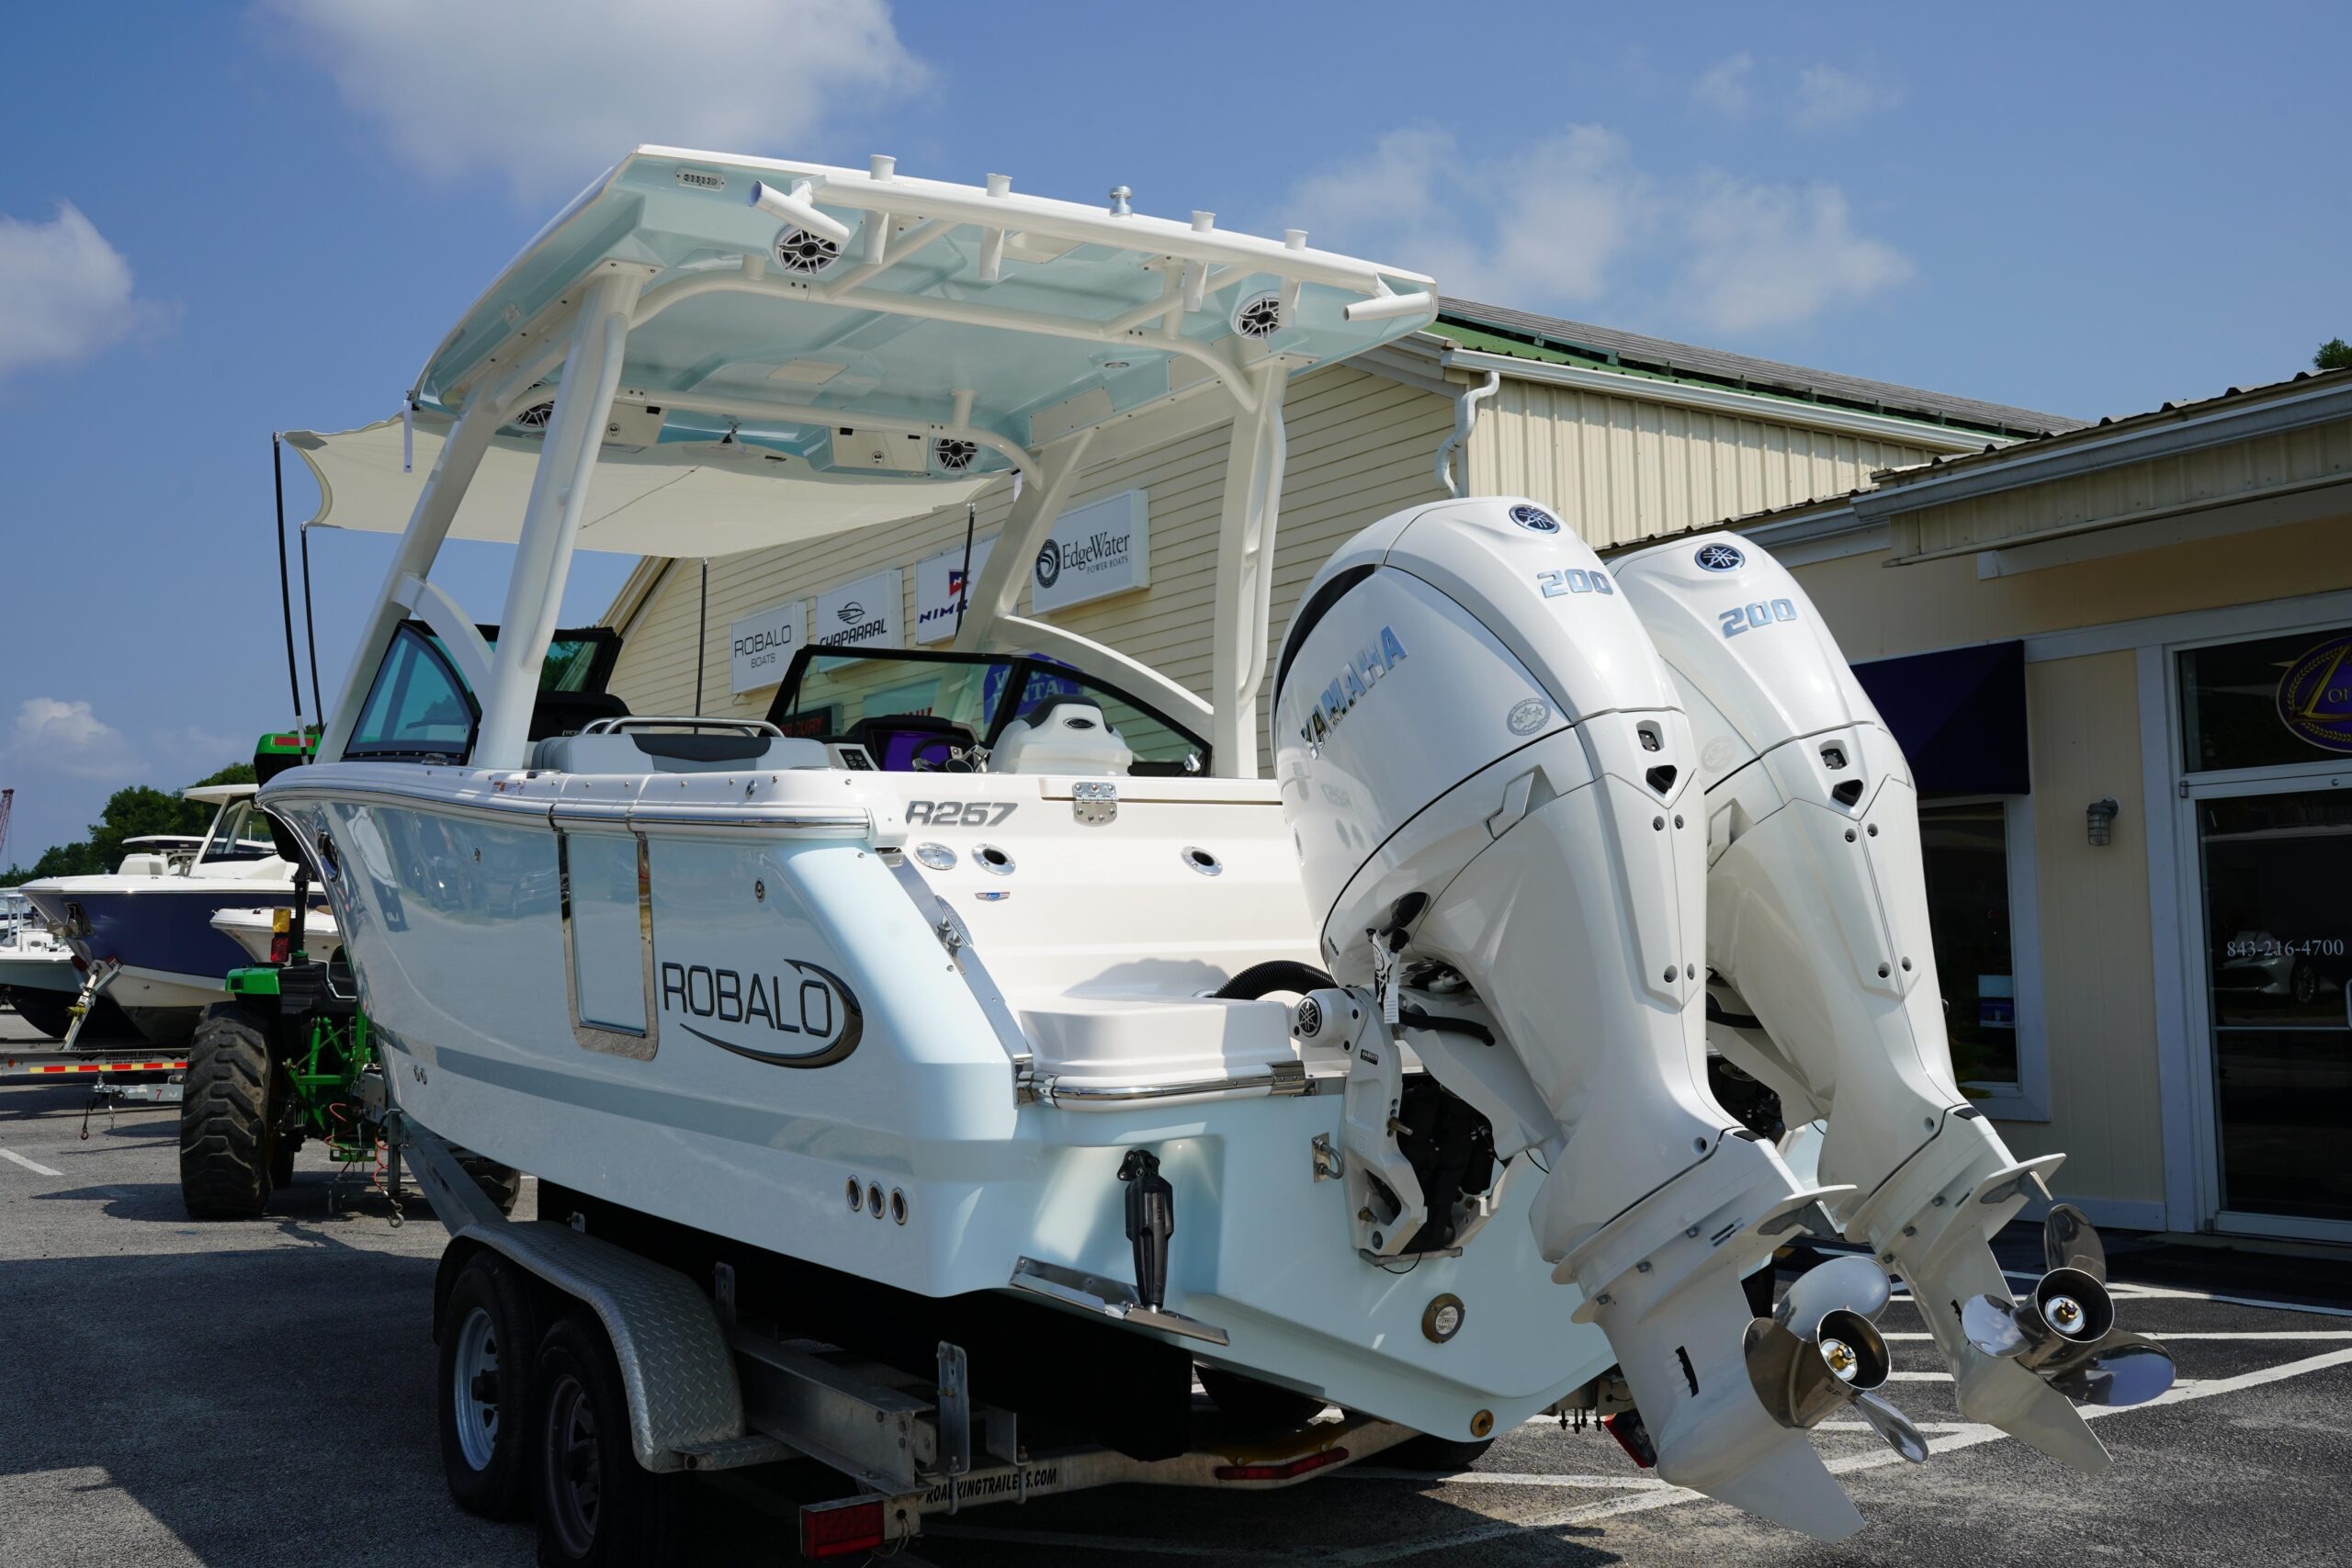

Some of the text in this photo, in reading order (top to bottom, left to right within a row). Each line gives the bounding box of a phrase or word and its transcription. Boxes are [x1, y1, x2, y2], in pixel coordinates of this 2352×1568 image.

[1062, 531, 1130, 571] EdgeWater
[1087, 555, 1129, 574] POWER BOATS
[1537, 568, 1614, 599] 200
[1718, 598, 1798, 639] 200
[734, 625, 792, 659] ROBALO
[751, 653, 776, 669] BOATS
[1300, 626, 1408, 761] YAMAHA
[905, 800, 1019, 827] R257
[2226, 939, 2345, 957] 843-216-4700
[662, 961, 832, 1038] ROBALO
